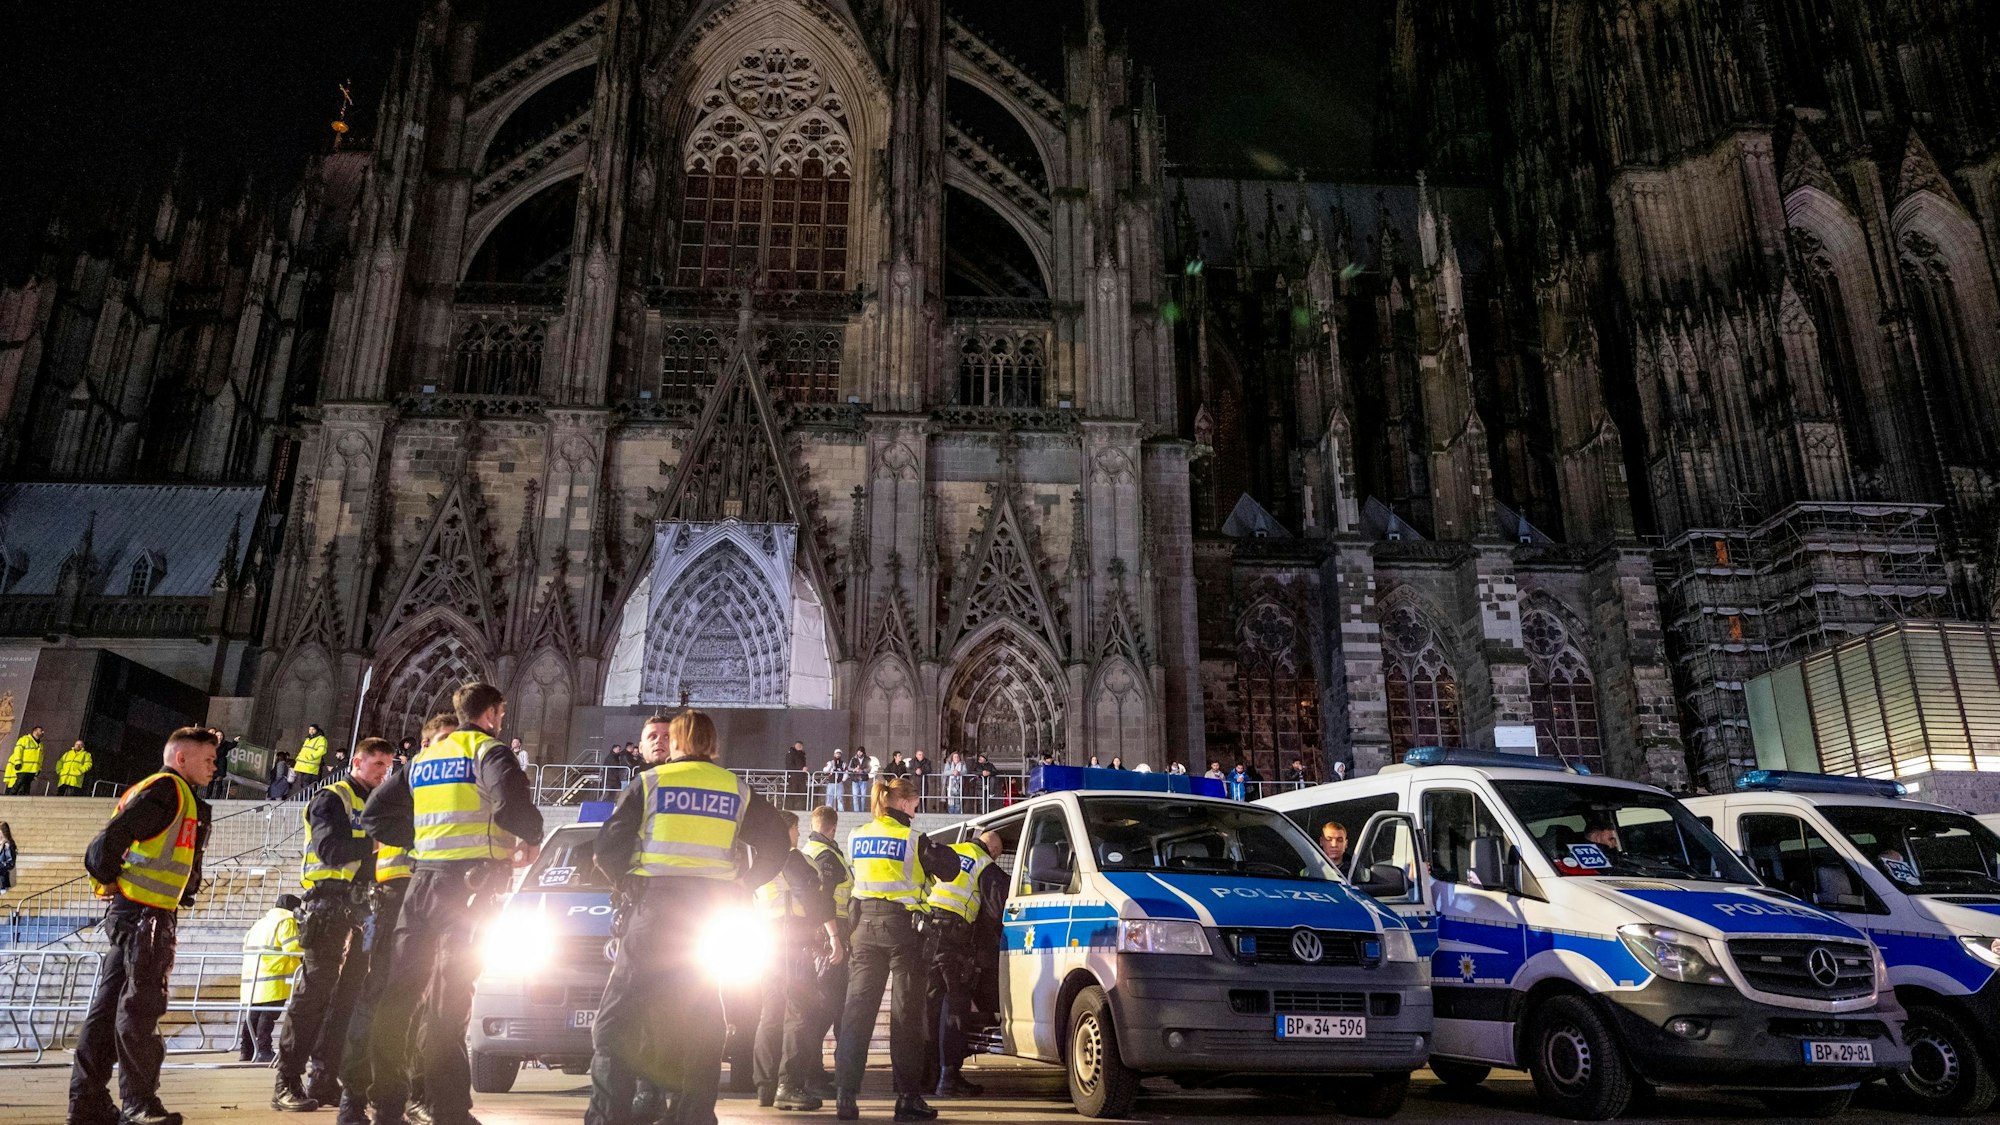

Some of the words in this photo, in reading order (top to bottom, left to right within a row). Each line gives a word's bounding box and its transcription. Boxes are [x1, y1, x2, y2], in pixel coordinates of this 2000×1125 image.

[226, 747, 262, 769] gang
[413, 760, 470, 783] POLIZEI
[664, 791, 734, 815] POLIZEI
[854, 839, 901, 856] POLIZEI
[1582, 856, 1604, 864] 224
[1209, 887, 1340, 904] POLIZEI
[1712, 903, 1828, 922] POLIZEI
[575, 1011, 595, 1026] BP
